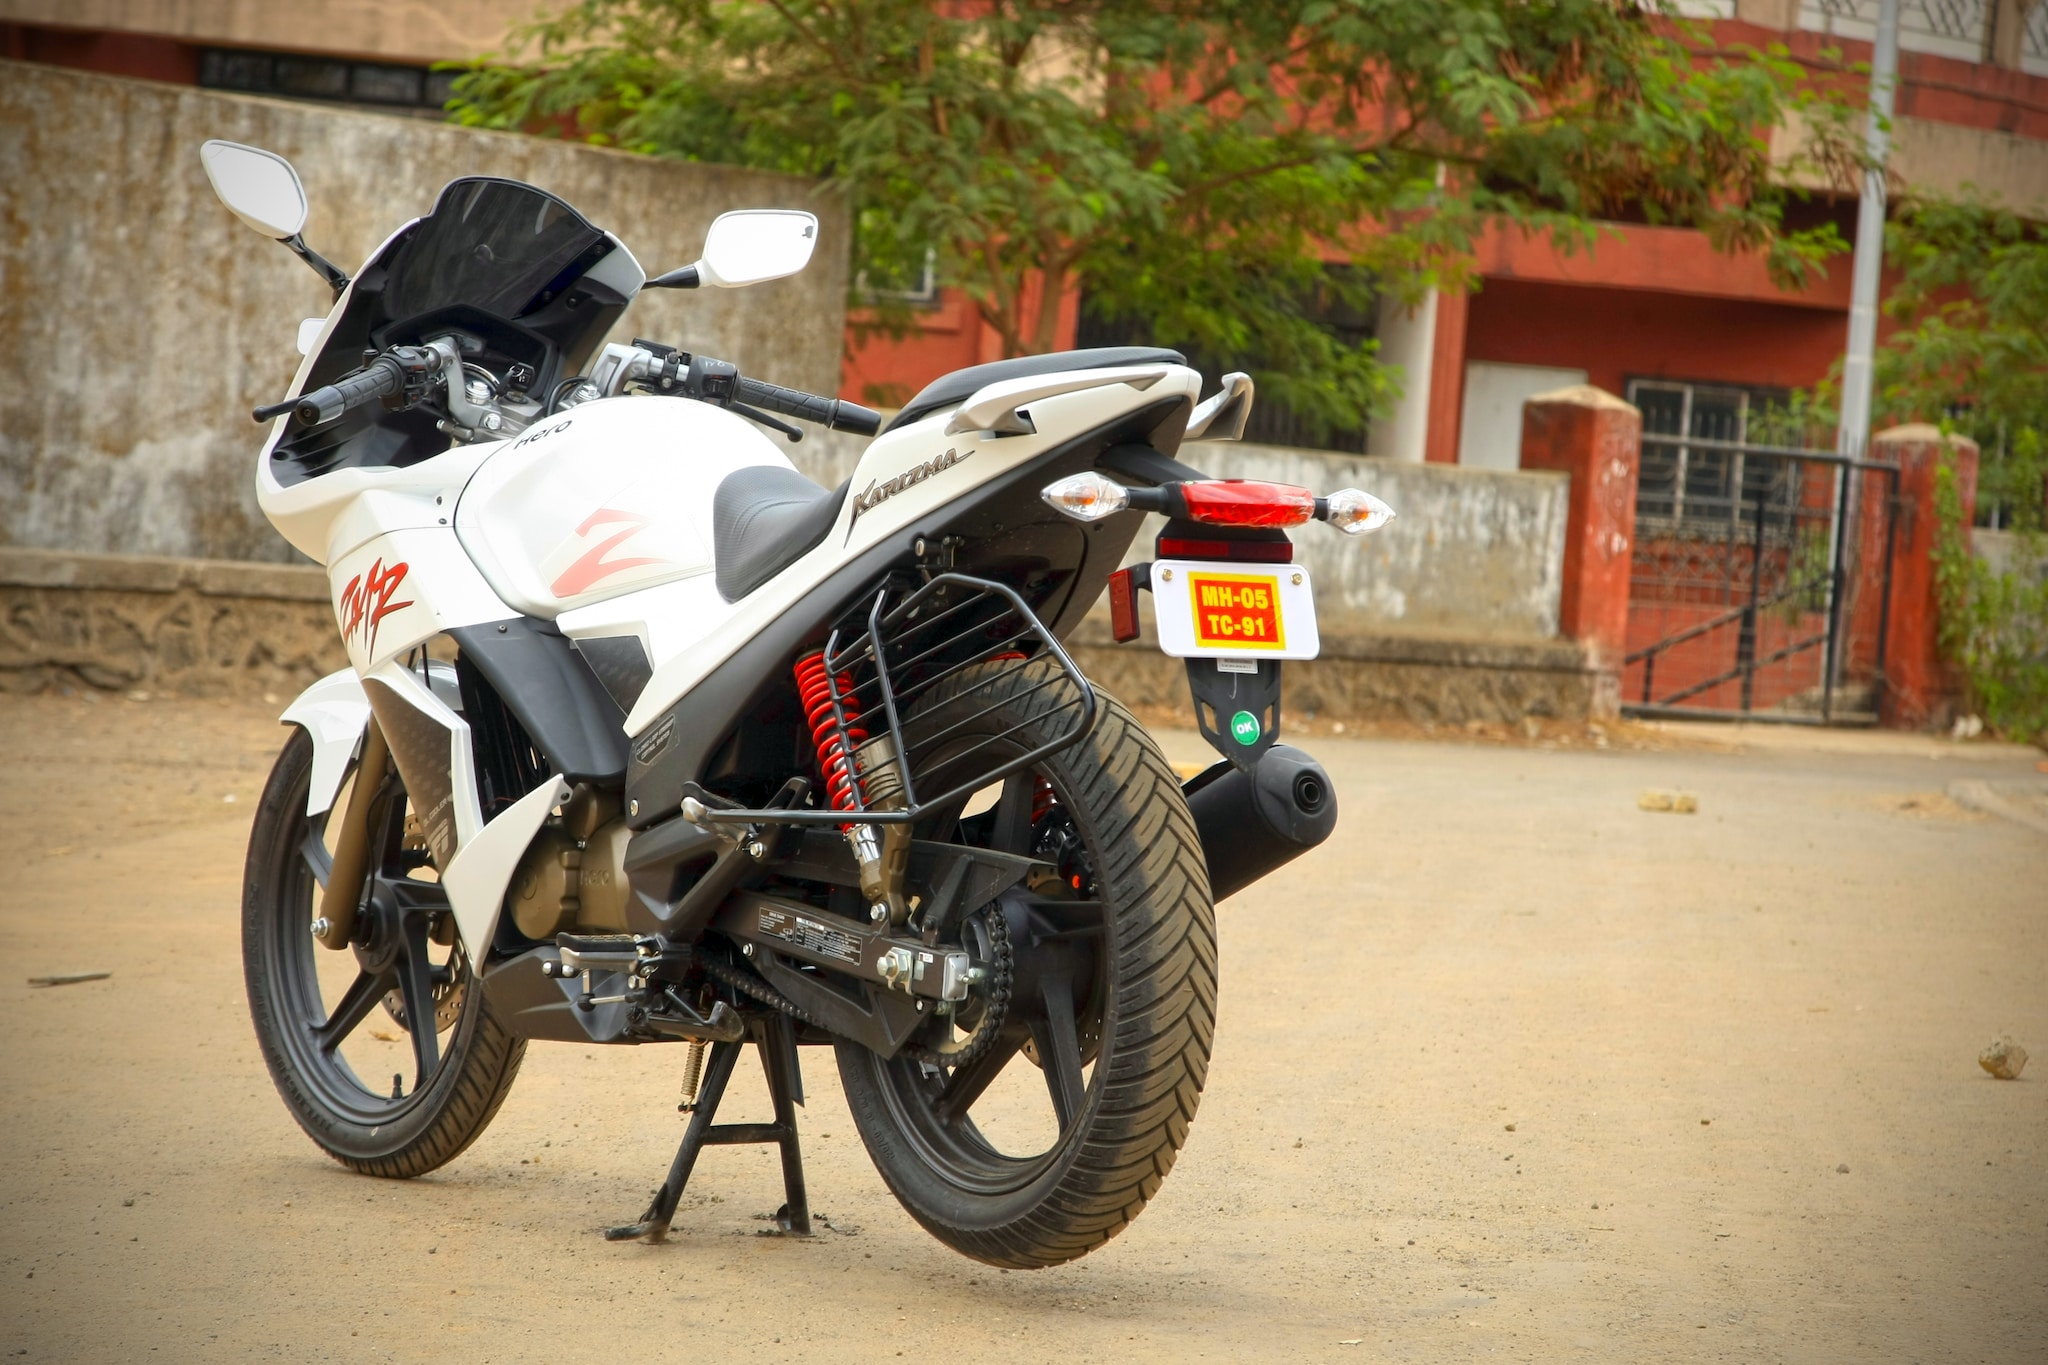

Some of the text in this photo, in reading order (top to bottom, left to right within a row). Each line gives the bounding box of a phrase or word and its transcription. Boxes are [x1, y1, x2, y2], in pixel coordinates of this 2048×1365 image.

[514, 420, 573, 450] Hero
[1201, 585, 1269, 610] MH-05
[1207, 614, 1265, 637] TC-91
[1236, 721, 1254, 735] OK
